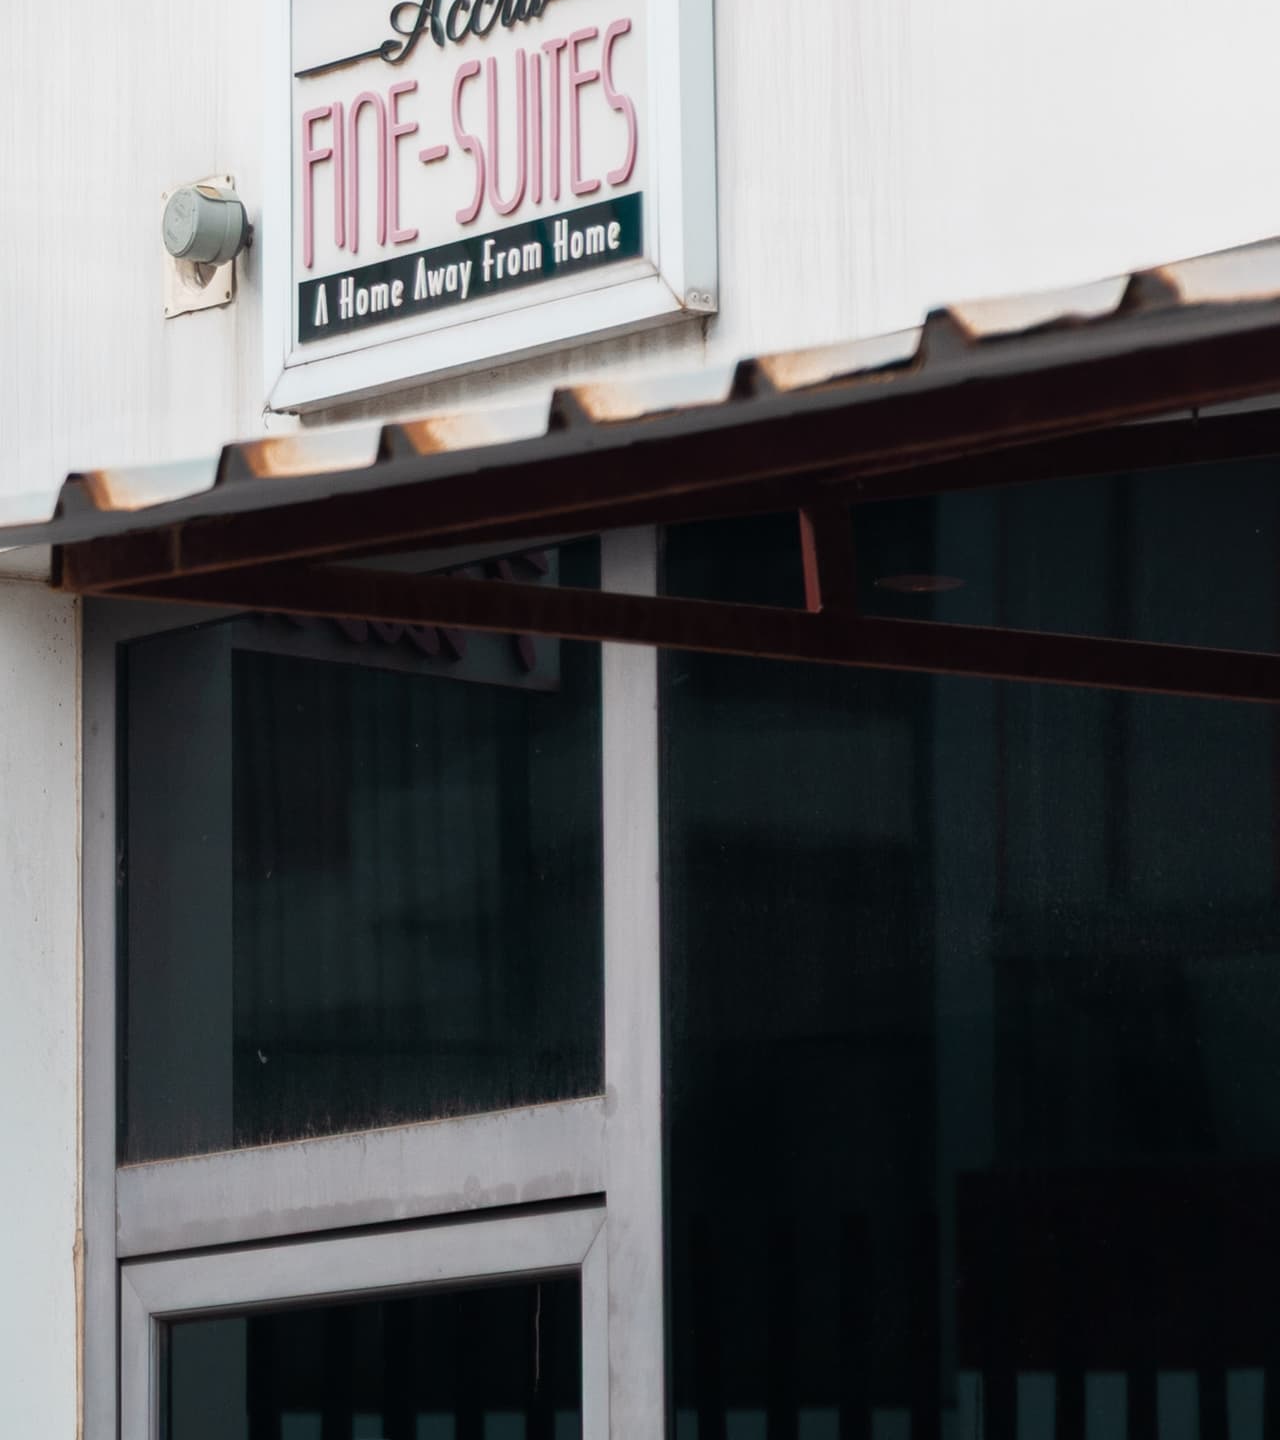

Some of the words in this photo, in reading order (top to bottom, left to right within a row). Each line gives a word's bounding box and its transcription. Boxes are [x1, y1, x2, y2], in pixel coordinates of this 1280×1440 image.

[301, 17, 638, 269] FINE-SUITES
[314, 283, 328, 327] A
[340, 276, 404, 320] Home
[414, 256, 473, 300] Away
[483, 239, 542, 283] From
[554, 219, 621, 264] Home
